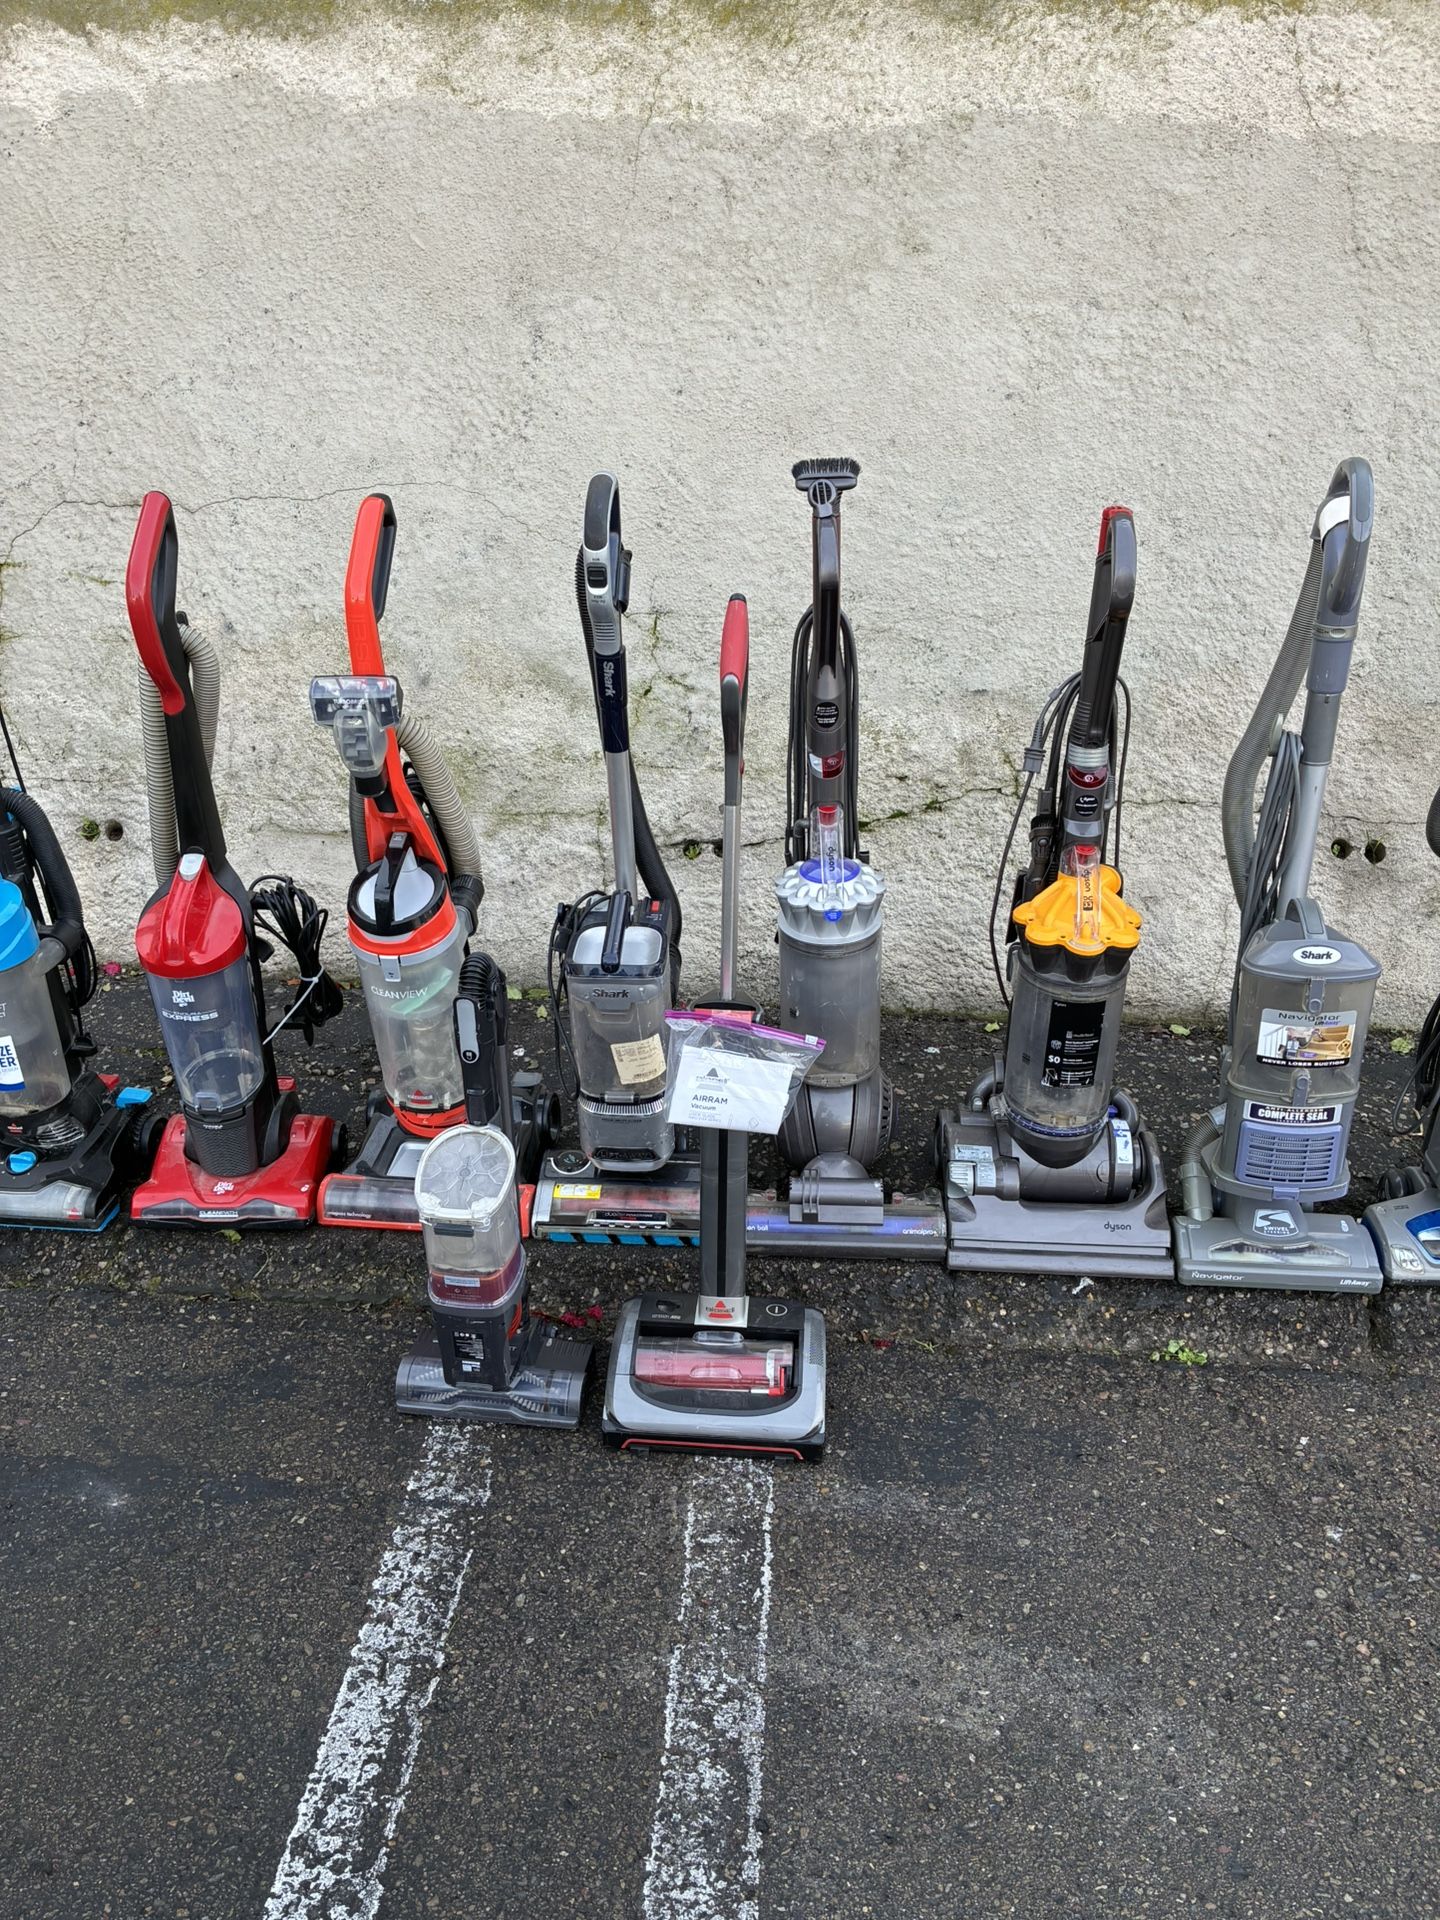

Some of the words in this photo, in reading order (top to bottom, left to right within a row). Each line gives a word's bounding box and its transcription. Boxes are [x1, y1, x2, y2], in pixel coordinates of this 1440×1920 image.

[603, 661, 616, 697] Shark
[826, 846, 837, 872] dyson
[1081, 869, 1092, 892] dyson
[1300, 950, 1333, 960] Shark
[370, 985, 428, 1000] CLEANVIEW
[593, 988, 630, 999] Shark
[162, 1011, 219, 1022] EXPRESS
[1278, 1012, 1342, 1023] Navigator
[1313, 1058, 1345, 1067] SUCTION
[692, 1094, 728, 1105] AIRRAM
[691, 1102, 716, 1110] Vacuum
[1258, 1108, 1305, 1121] COMPLETE
[1306, 1111, 1329, 1121] SEAL
[1104, 1221, 1132, 1232] dyson
[1191, 1271, 1245, 1281] Navigator
